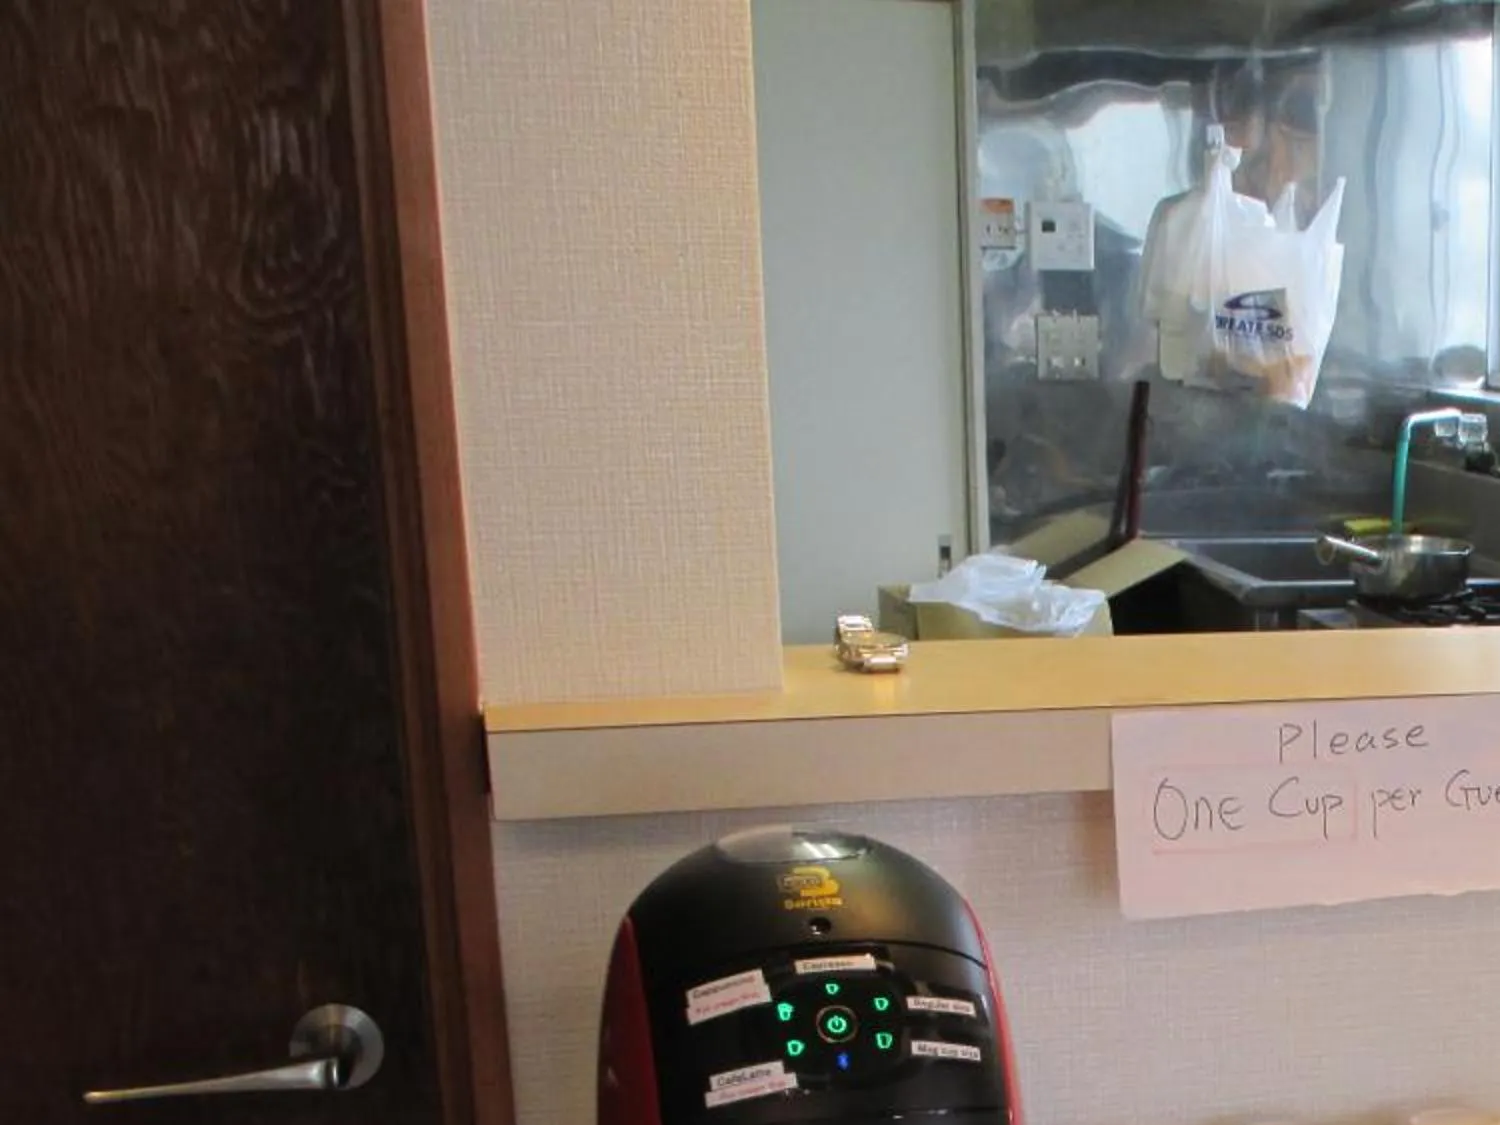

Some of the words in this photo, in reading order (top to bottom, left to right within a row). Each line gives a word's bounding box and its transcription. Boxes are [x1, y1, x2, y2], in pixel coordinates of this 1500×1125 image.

[1278, 720, 1430, 764] Please
[1152, 777, 1246, 841] One
[1267, 775, 1345, 839] Cup
[1370, 788, 1423, 837] per
